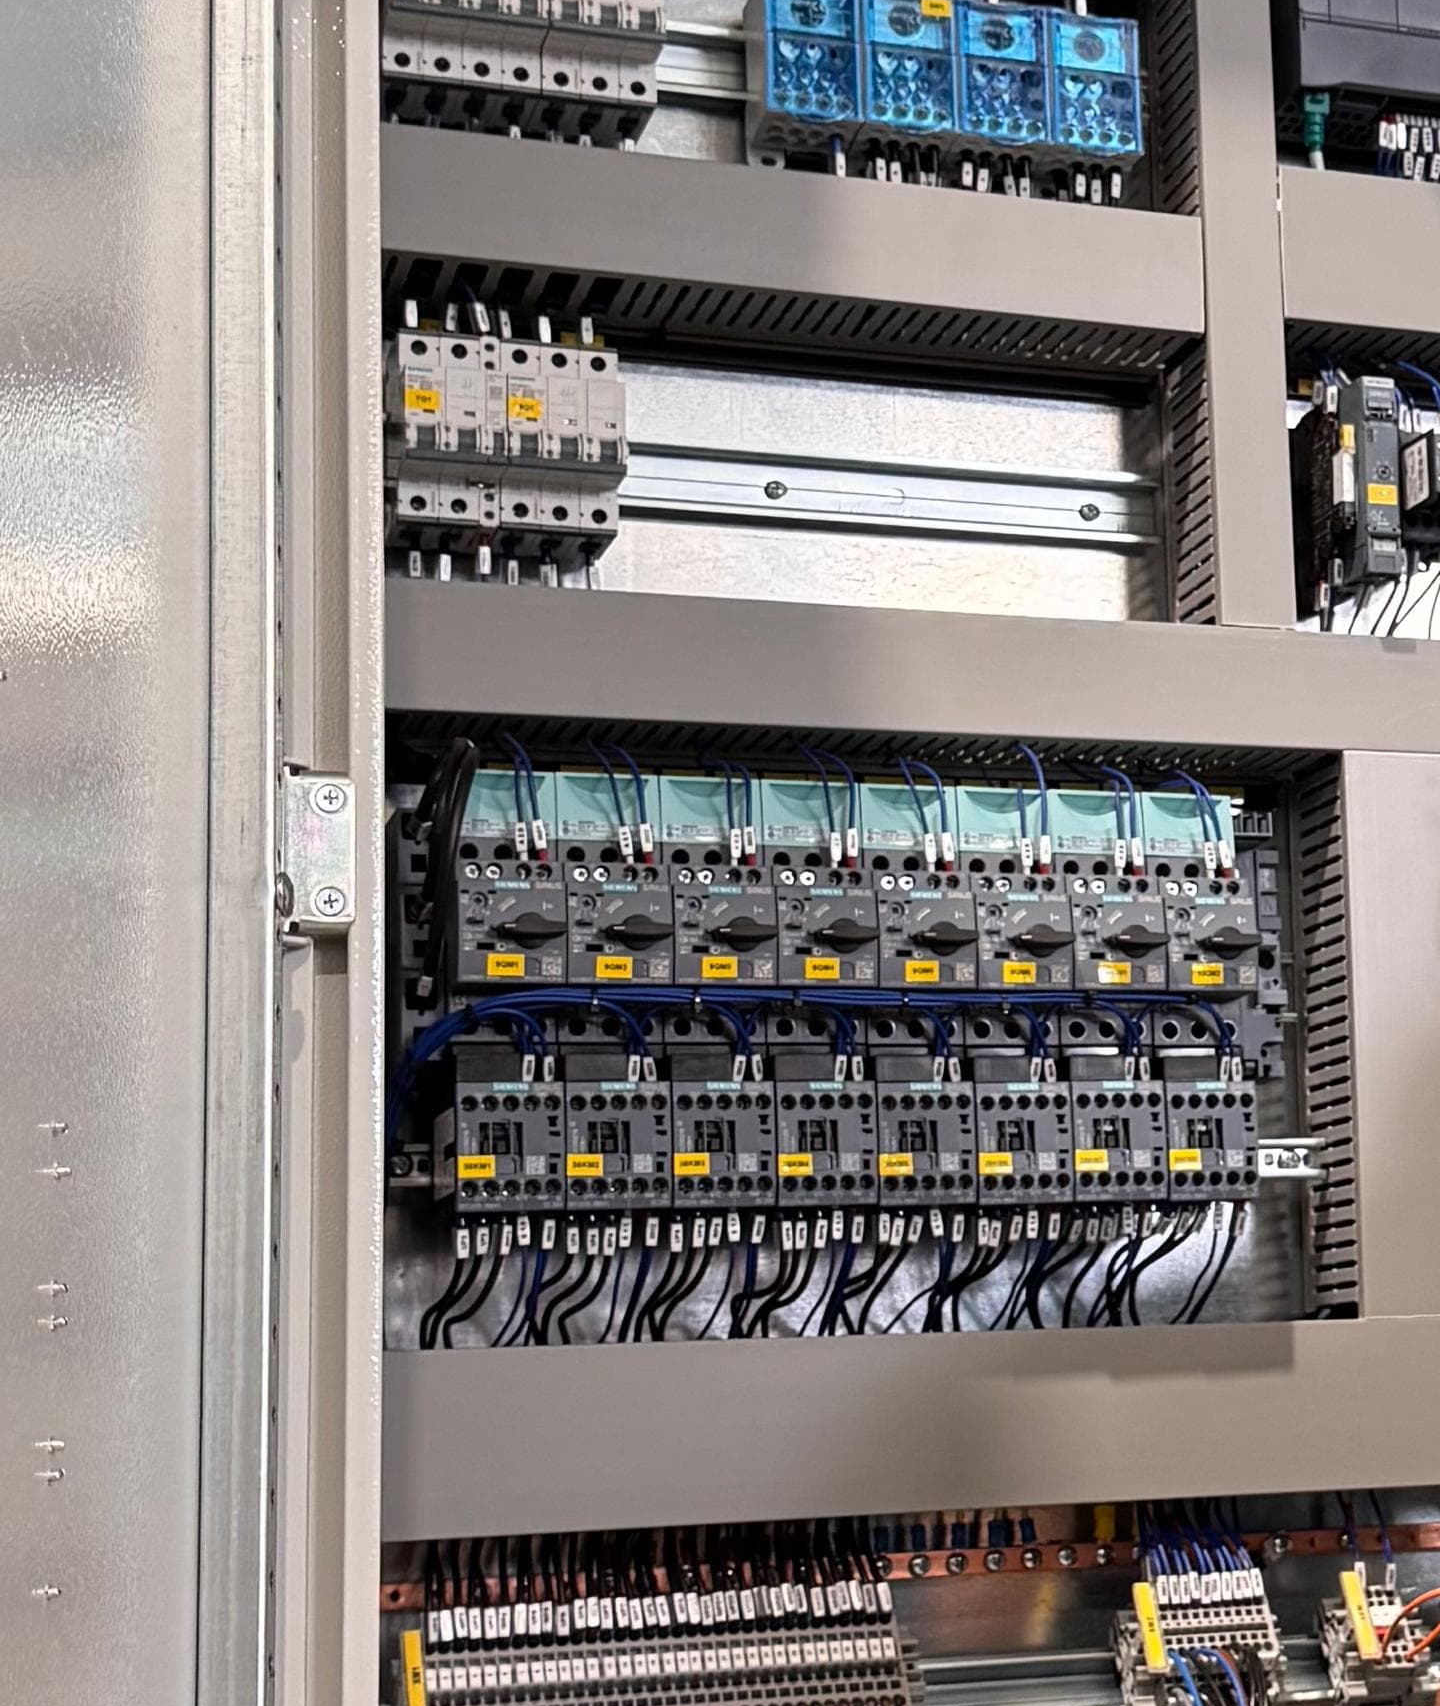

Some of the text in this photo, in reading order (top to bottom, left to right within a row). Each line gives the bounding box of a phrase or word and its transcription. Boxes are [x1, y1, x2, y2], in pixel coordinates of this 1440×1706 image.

[494, 880, 531, 890] SIEMENS
[602, 883, 638, 892] SIEMENS
[708, 886, 743, 894] SIEMENS
